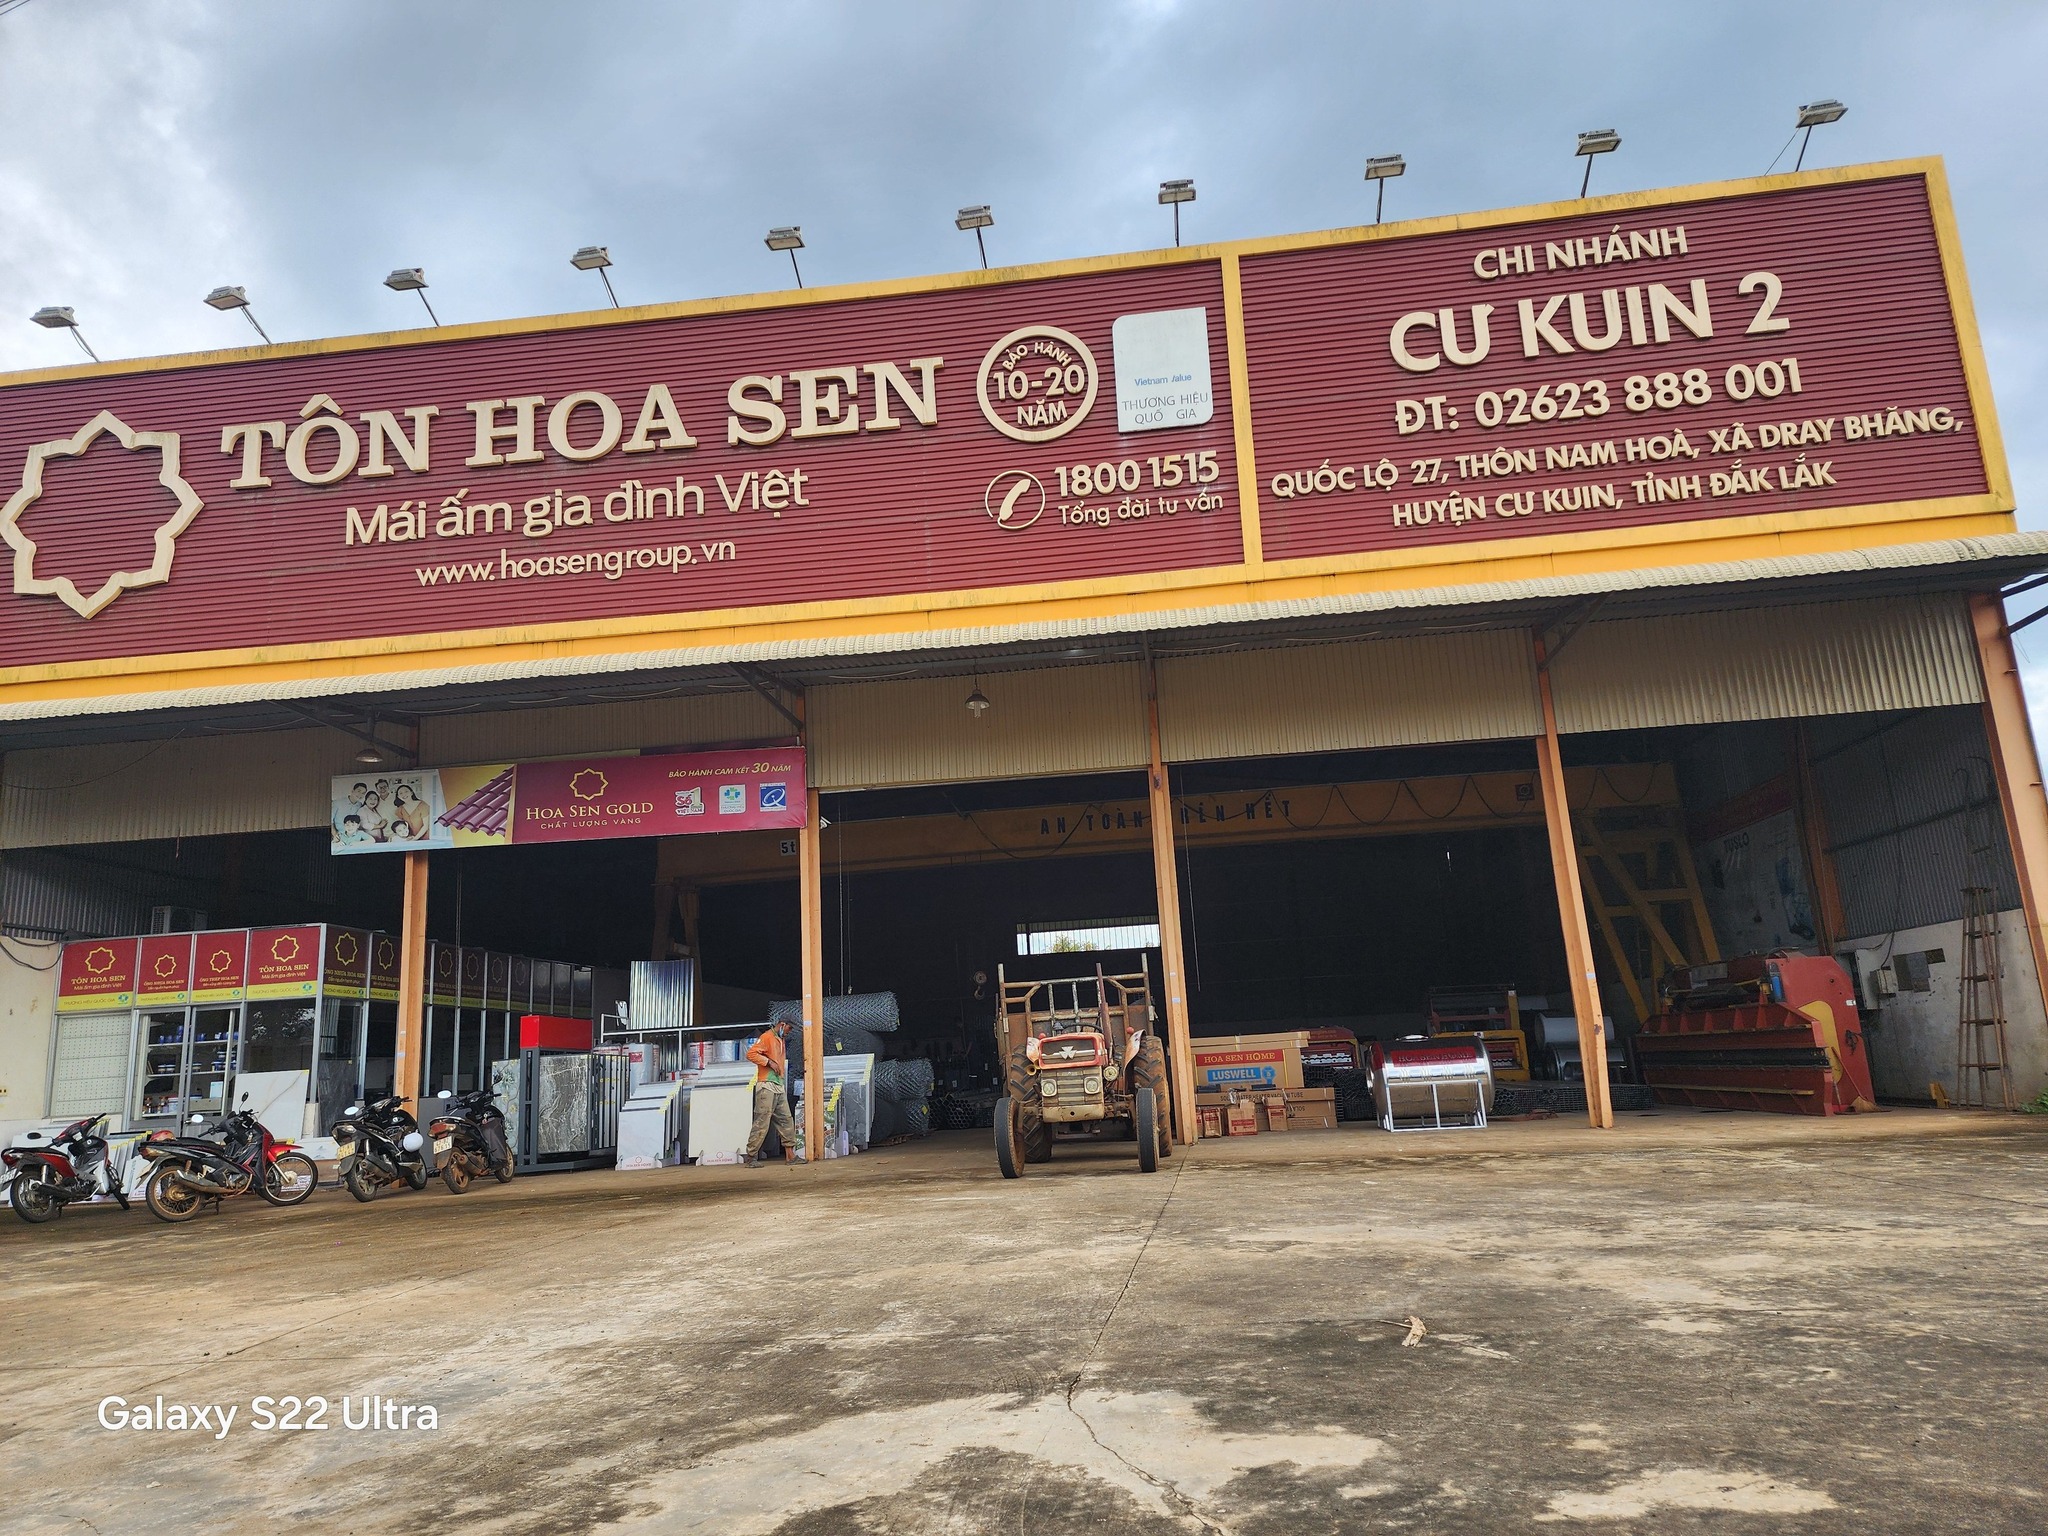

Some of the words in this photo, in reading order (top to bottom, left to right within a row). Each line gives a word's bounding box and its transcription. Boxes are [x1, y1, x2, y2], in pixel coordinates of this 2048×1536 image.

[1473, 245, 1536, 279] CHI
[1545, 224, 1689, 270] NHÁNH
[1389, 302, 1495, 372] CƯ
[1517, 278, 1714, 358] KUIN
[1738, 271, 1791, 335] 2
[1002, 344, 1028, 371] BẢO
[993, 364, 1085, 401] 10-20
[1134, 376, 1168, 386] Vietnam
[1394, 395, 1460, 435] ĐT:
[1474, 379, 1611, 428] 02623
[1623, 367, 1713, 412] 888
[1724, 357, 1803, 401] 001
[221, 393, 439, 489] TÔN
[465, 384, 698, 467] HOA
[727, 357, 944, 446] SEN
[1017, 399, 1068, 426] NĂM
[1134, 408, 1164, 425] QUỐ
[1176, 407, 1197, 420] GIA
[1054, 459, 1141, 497] 1800
[1147, 450, 1220, 488] 1515
[1270, 458, 1356, 499] QUỐC
[1363, 457, 1399, 491] LỘ
[1410, 457, 1450, 485] 27,
[1455, 446, 1537, 479] THÔN
[1545, 440, 1618, 470] NAM
[1625, 427, 1700, 462] HOÀ,
[1707, 421, 1754, 454] XÃ
[1759, 418, 1836, 448] DRAY
[1392, 490, 1487, 527] HUYỆN
[1494, 490, 1535, 517] CƯ
[1542, 483, 1624, 513] KUIN,
[1631, 471, 1702, 504] TỈNH
[1709, 458, 1774, 497] ĐẮK
[1778, 453, 1837, 490] LẮK
[345, 500, 427, 546] Mái
[435, 487, 513, 537] ấm
[522, 488, 594, 538] gia
[603, 476, 705, 523] đình
[715, 468, 810, 518] Việt
[1058, 500, 1110, 527] Tổng
[1117, 497, 1150, 519] đài
[1158, 497, 1179, 515] tư
[1185, 487, 1224, 512] vấn
[751, 762, 770, 773] 30
[526, 807, 564, 820] HOA
[570, 804, 600, 817] SEN
[606, 802, 654, 815] GOLD
[540, 819, 567, 830] CHẤT
[572, 819, 608, 828] LƯỢNG
[613, 817, 641, 825] VÀNG
[1040, 817, 1066, 835] AN
[1086, 807, 1143, 831] TOÀN
[1180, 802, 1225, 824] RÊN
[781, 841, 796, 854] 5t
[90, 975, 107, 983] HOA
[1204, 1055, 1223, 1063] HOA
[1225, 1054, 1244, 1062] SEN
[1246, 1052, 1275, 1061] HOME
[1212, 1069, 1256, 1080] LUSWELL
